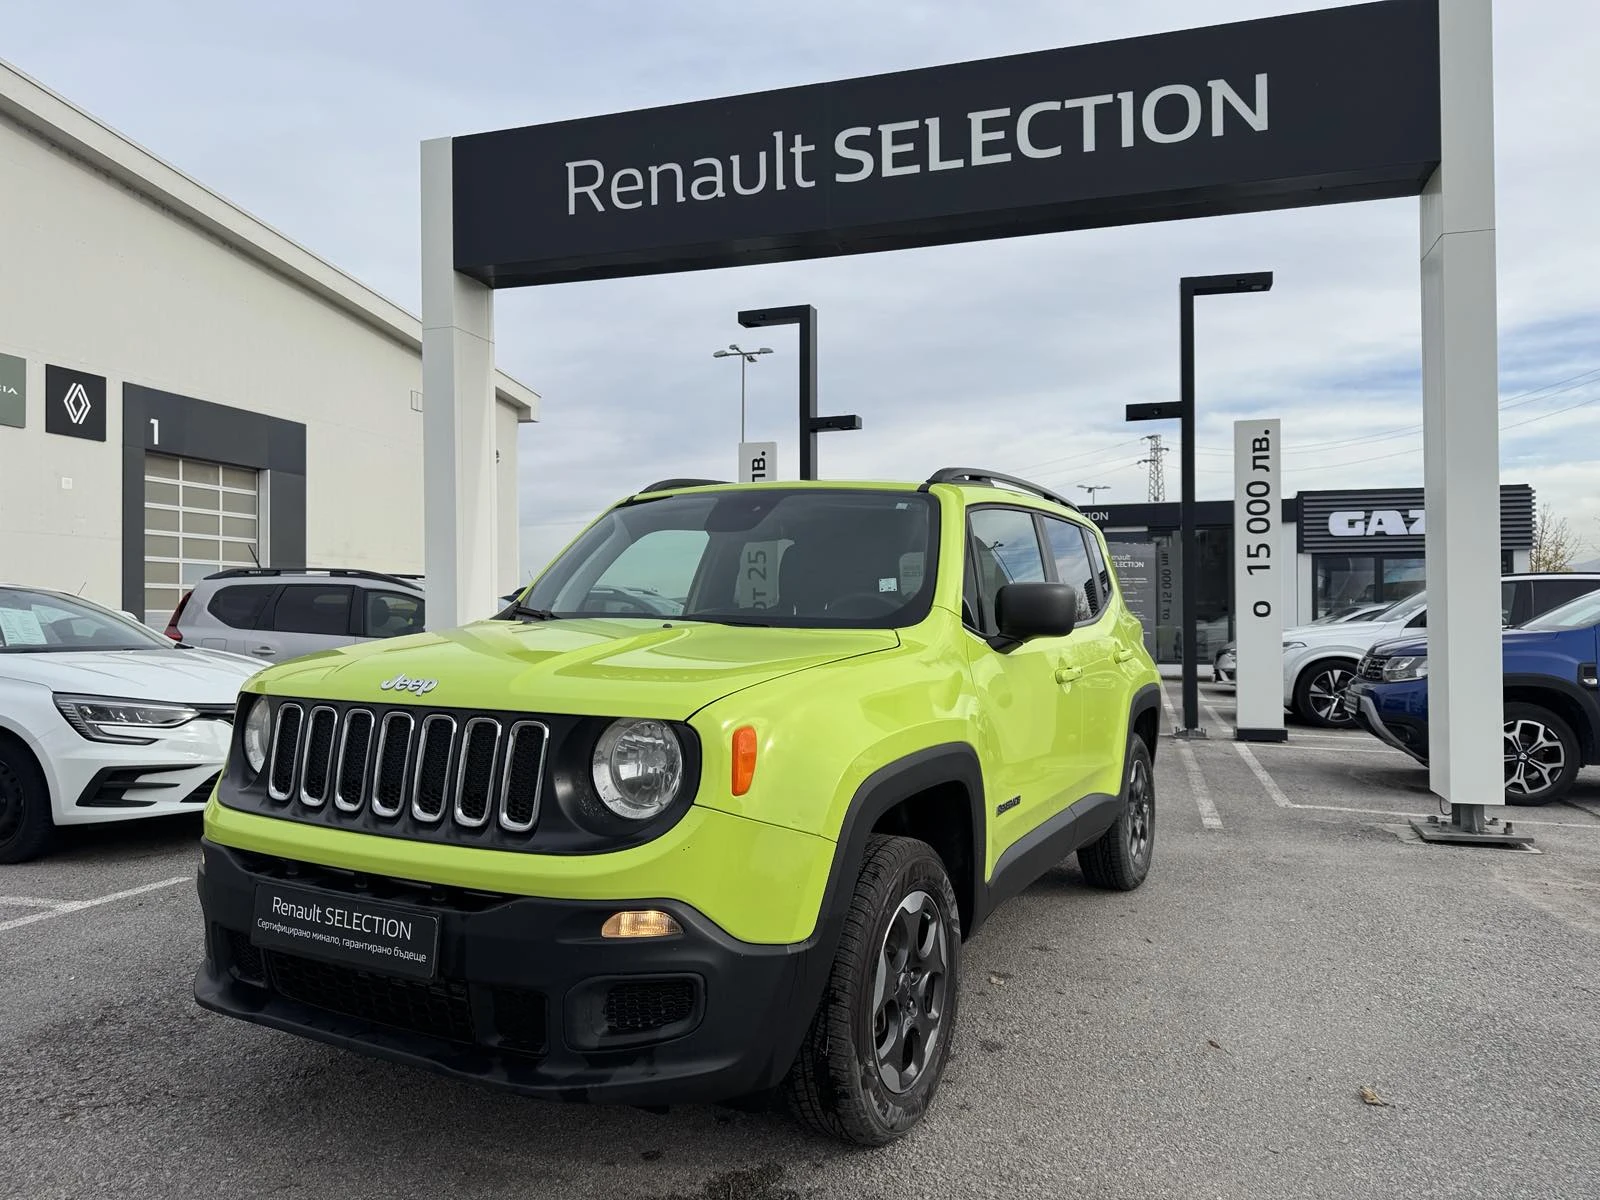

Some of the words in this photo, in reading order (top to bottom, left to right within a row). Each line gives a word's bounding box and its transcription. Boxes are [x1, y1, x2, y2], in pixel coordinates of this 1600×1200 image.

[566, 131, 816, 215] Renault
[835, 73, 1269, 182] SELECTION
[150, 418, 159, 445] 1
[1246, 480, 1271, 534] 000
[747, 551, 767, 581] 25
[1247, 543, 1271, 576] 15
[380, 672, 439, 697] Jeep
[272, 896, 322, 923] Renault
[325, 907, 412, 941] SELECTION
[257, 918, 312, 938] Сертифицирано
[311, 931, 341, 946] минало,
[342, 938, 393, 955] гарантирано
[393, 946, 428, 963] бъдеще
